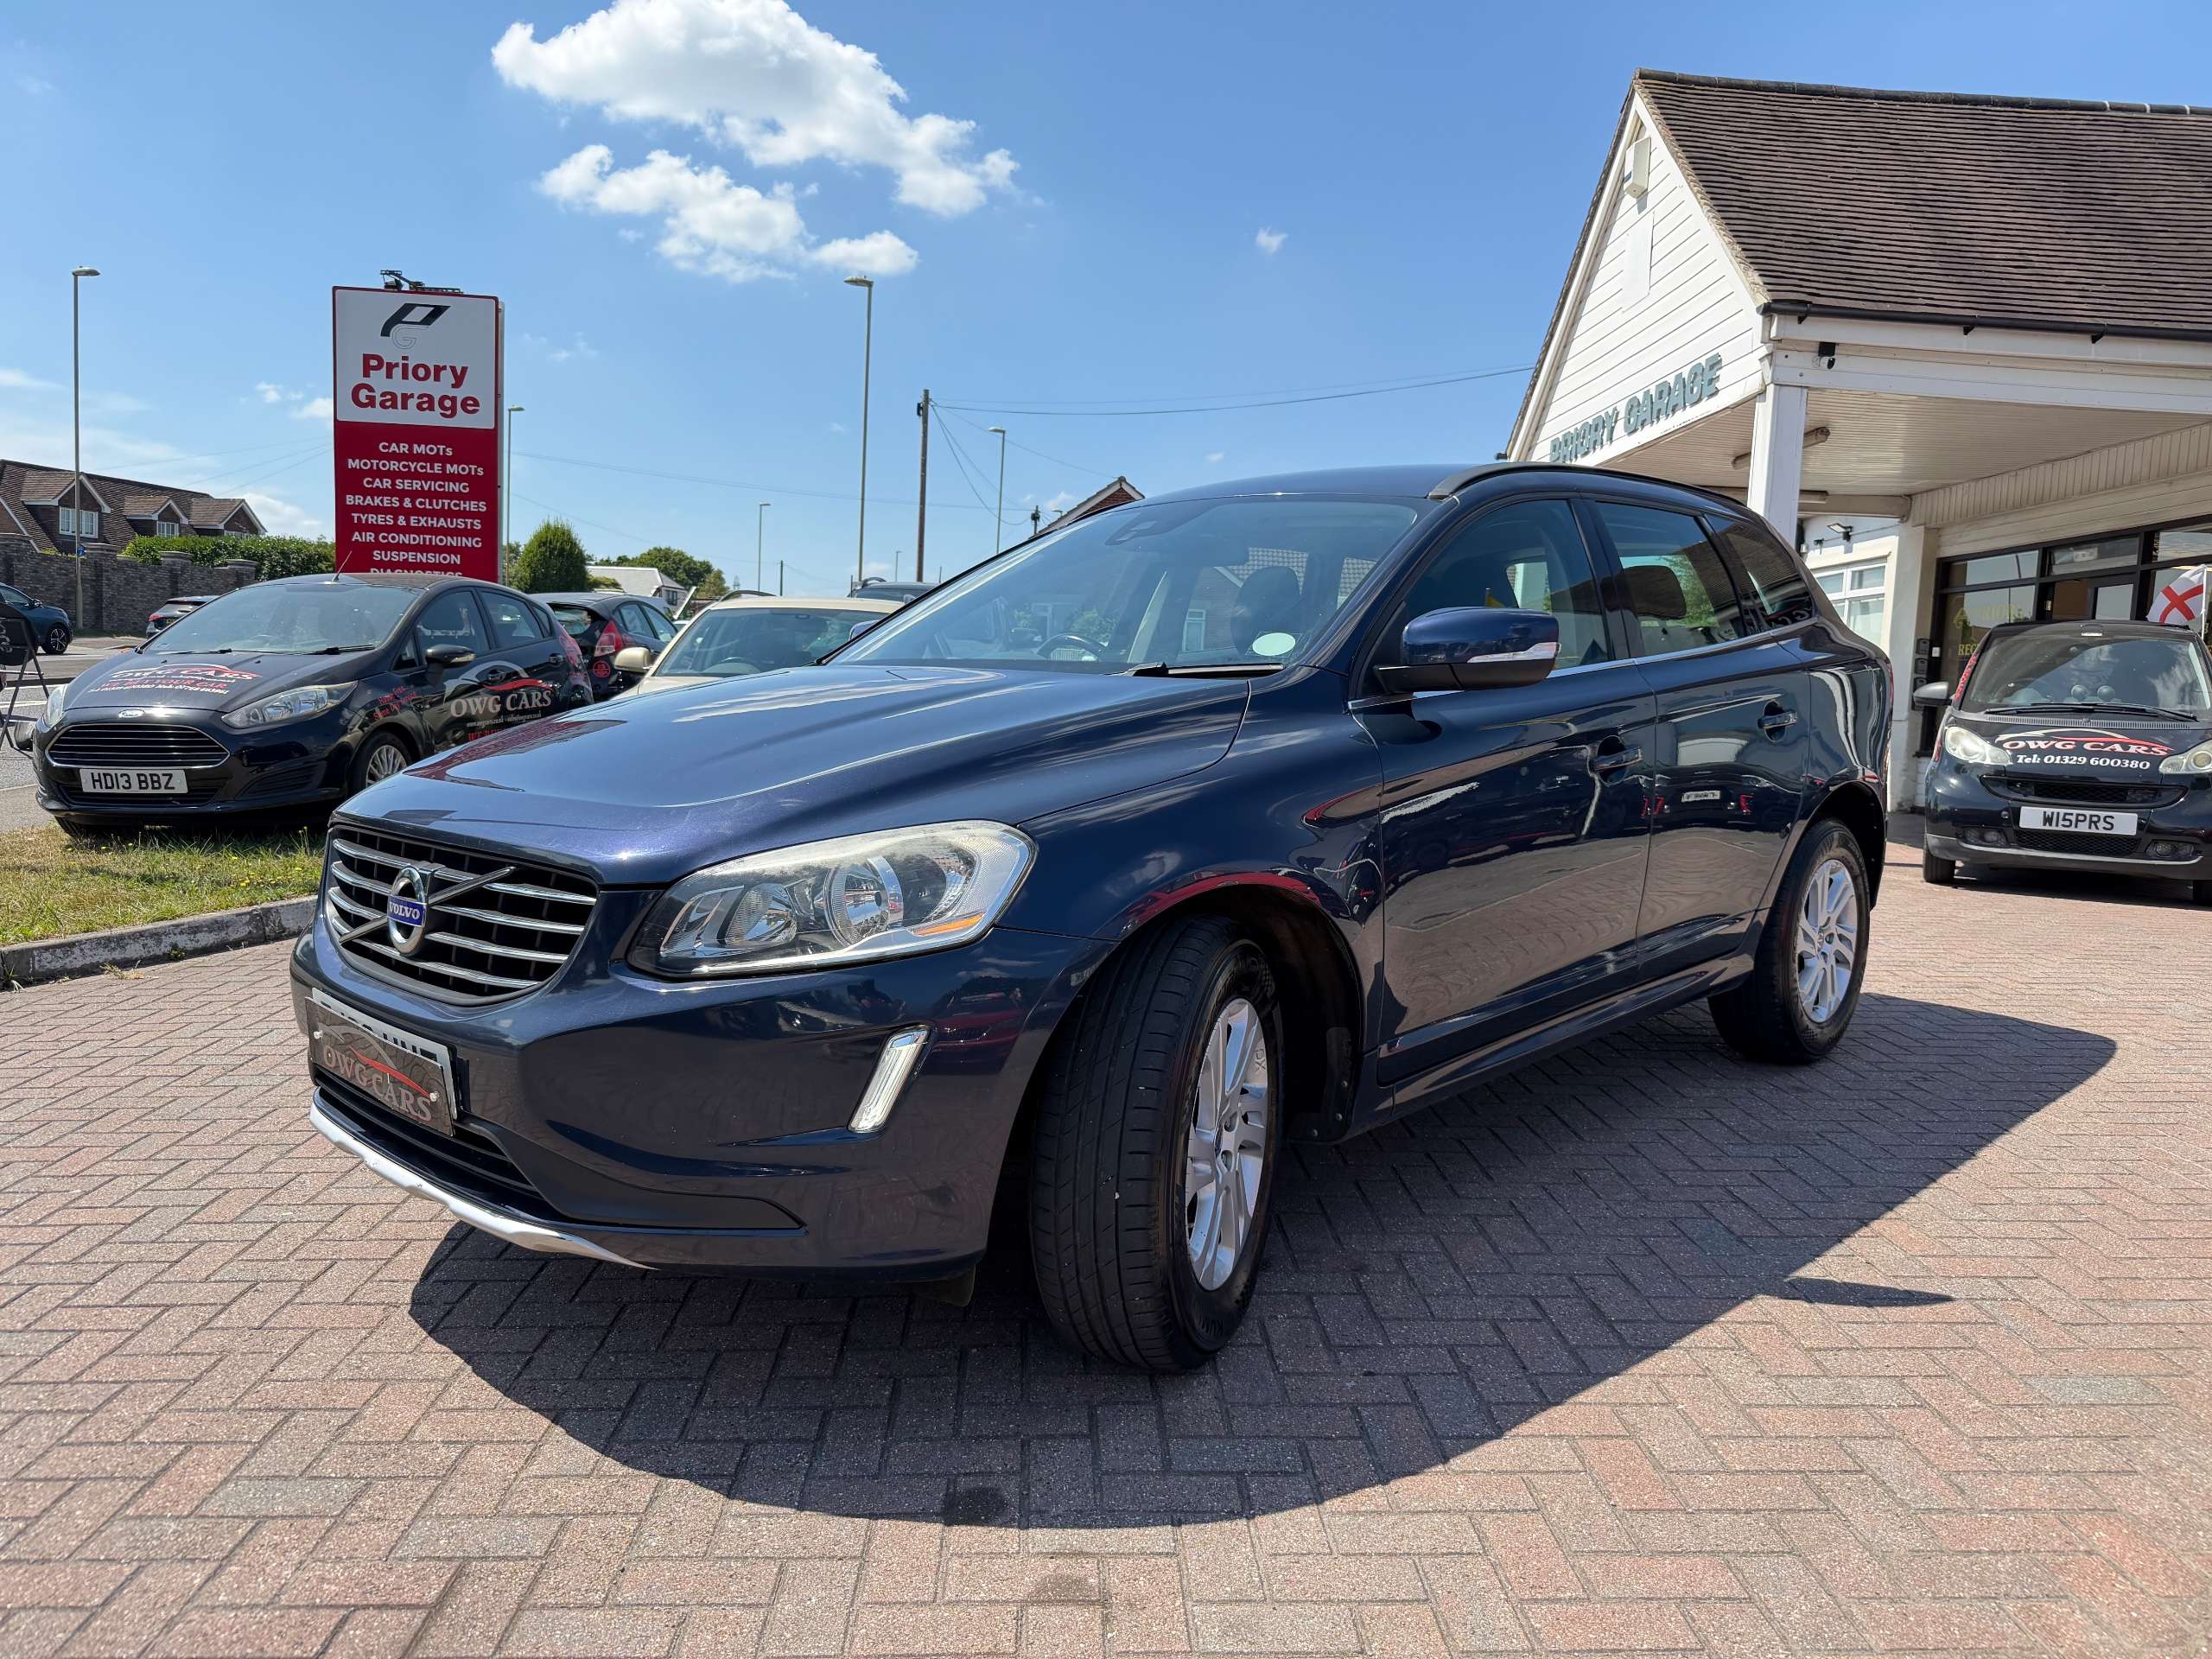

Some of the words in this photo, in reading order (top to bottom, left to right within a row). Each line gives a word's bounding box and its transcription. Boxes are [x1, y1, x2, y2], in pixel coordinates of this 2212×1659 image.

[363, 353, 468, 388] Priory
[351, 383, 480, 419] Garage
[1549, 407, 1619, 463] PRIORY
[1623, 353, 1723, 435] GARAGE
[378, 442, 409, 454] CAR
[413, 443, 453, 456] MOTs
[347, 459, 442, 474] MOTORCYCLE
[446, 463, 484, 476] MOTs
[363, 477, 391, 489] CAR
[395, 479, 470, 493] SERVICING
[346, 494, 400, 507] BRAKES
[403, 497, 413, 508] &
[416, 498, 487, 512] CLUTCHES
[351, 512, 394, 525] TYRES
[397, 515, 407, 526] &
[410, 516, 482, 530] EXHAUSTS
[351, 531, 375, 543] AIR
[378, 533, 482, 548] CONDITIONING
[372, 550, 461, 564] SUSPENSION
[450, 695, 502, 718] OWG
[505, 690, 552, 711] CARS
[2002, 741, 2076, 751] OWG
[2082, 741, 2170, 757] CARS
[2016, 754, 2041, 764] Tel:
[2044, 754, 2087, 765] 01329
[2089, 757, 2151, 770] 600380
[90, 772, 132, 790] HD13
[137, 772, 175, 791] BBZ
[389, 901, 421, 920] VOLVO
[323, 1045, 371, 1087] OWG
[372, 1073, 432, 1122] CARS
